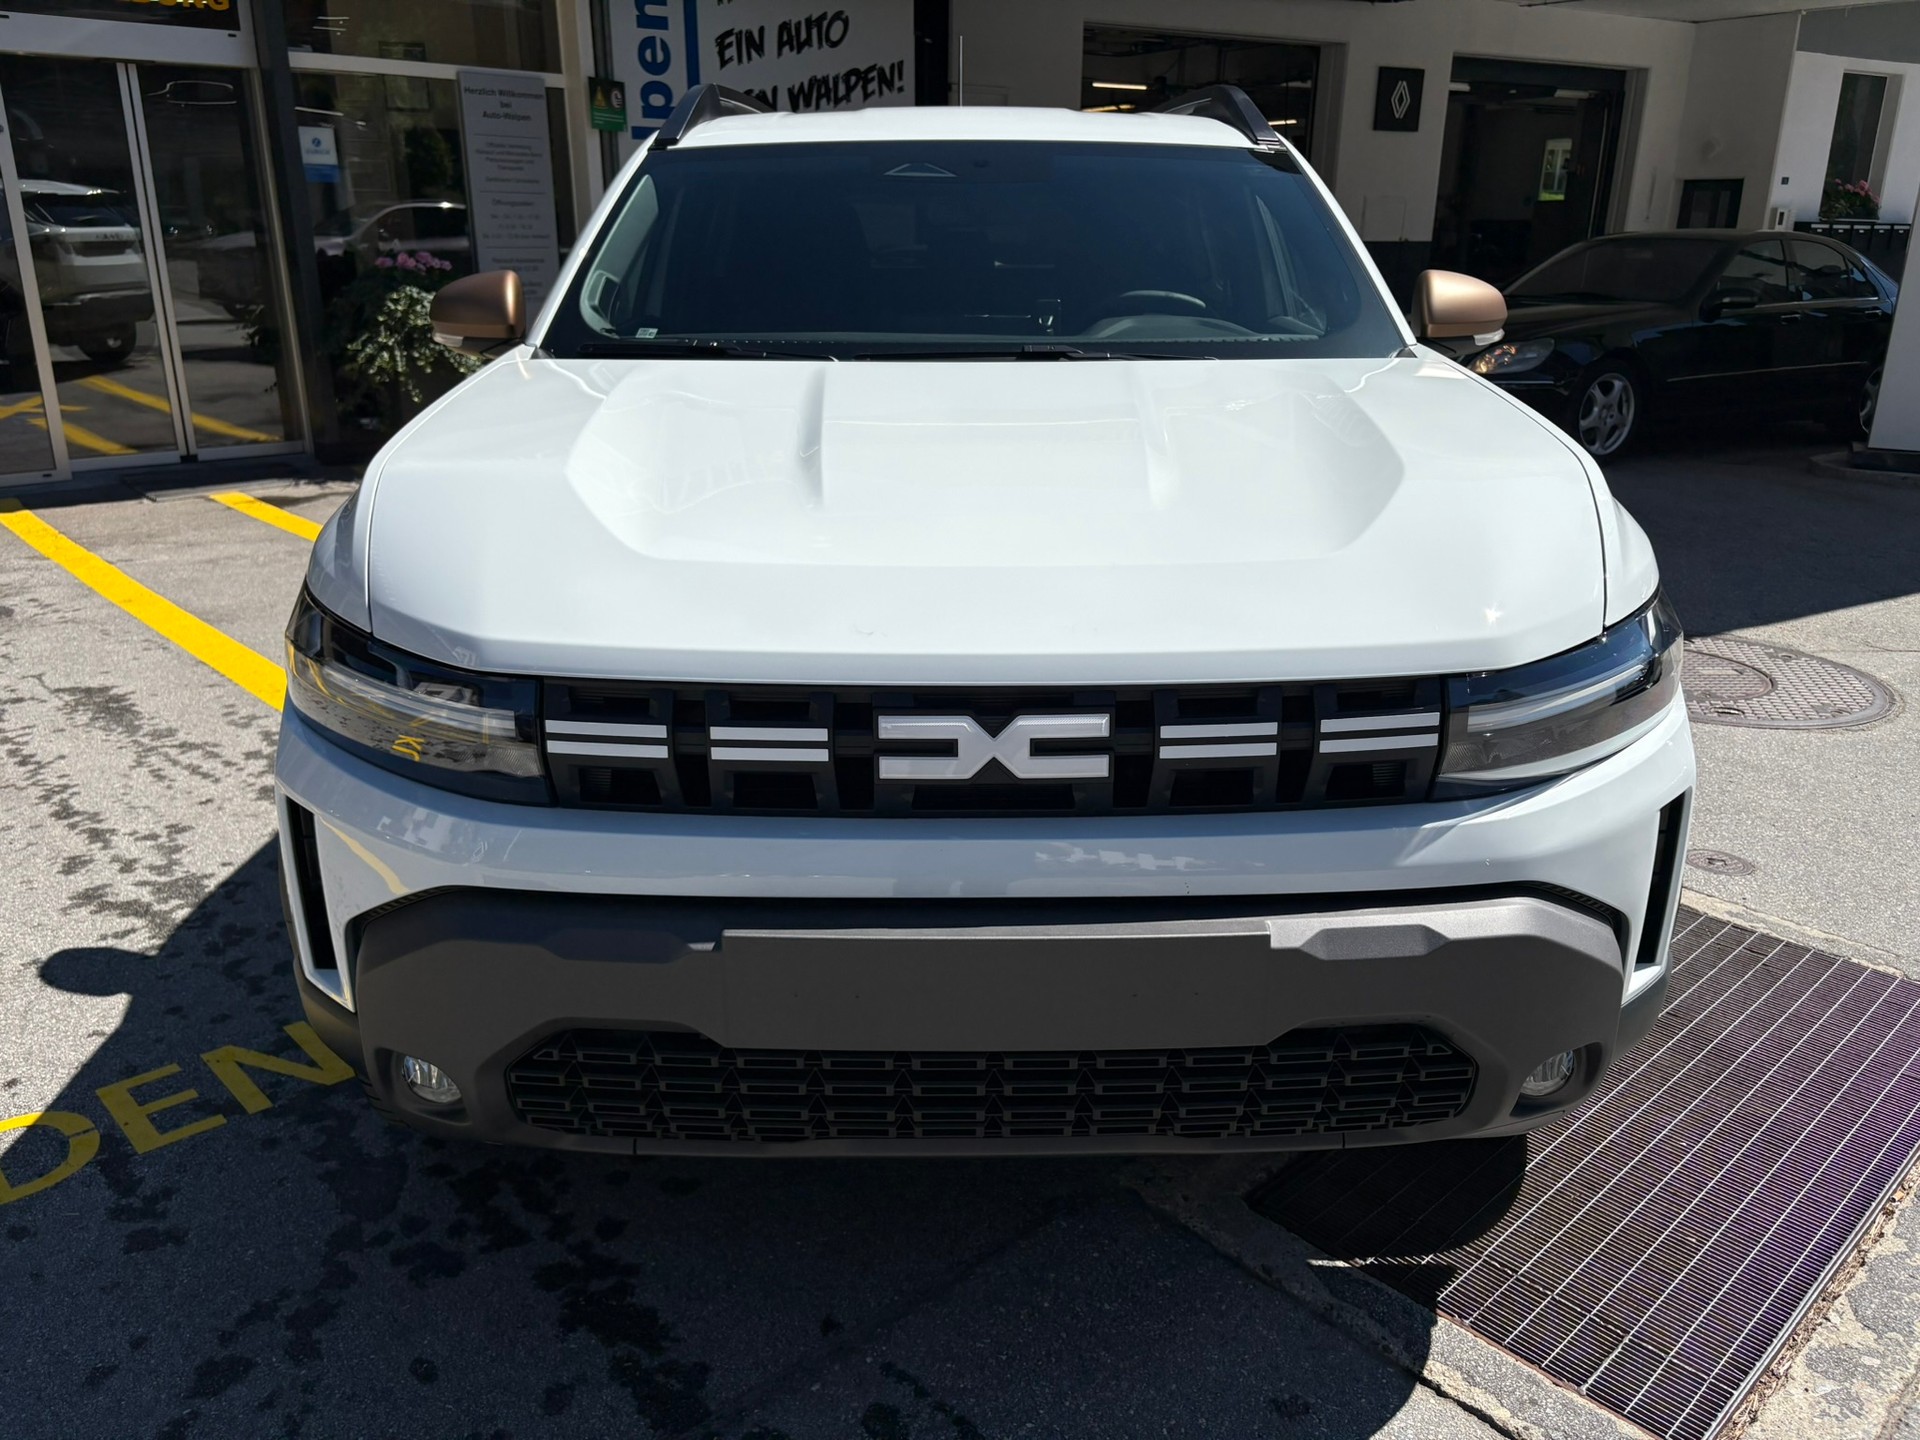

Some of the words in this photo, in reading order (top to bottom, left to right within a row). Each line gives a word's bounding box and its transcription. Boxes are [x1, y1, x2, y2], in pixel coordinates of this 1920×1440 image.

[715, 25, 765, 70] EIN
[777, 10, 850, 58] AUTO
[464, 86, 497, 97] Herzlich
[498, 89, 545, 100] Willkommen
[787, 60, 904, 113] WALPEN!
